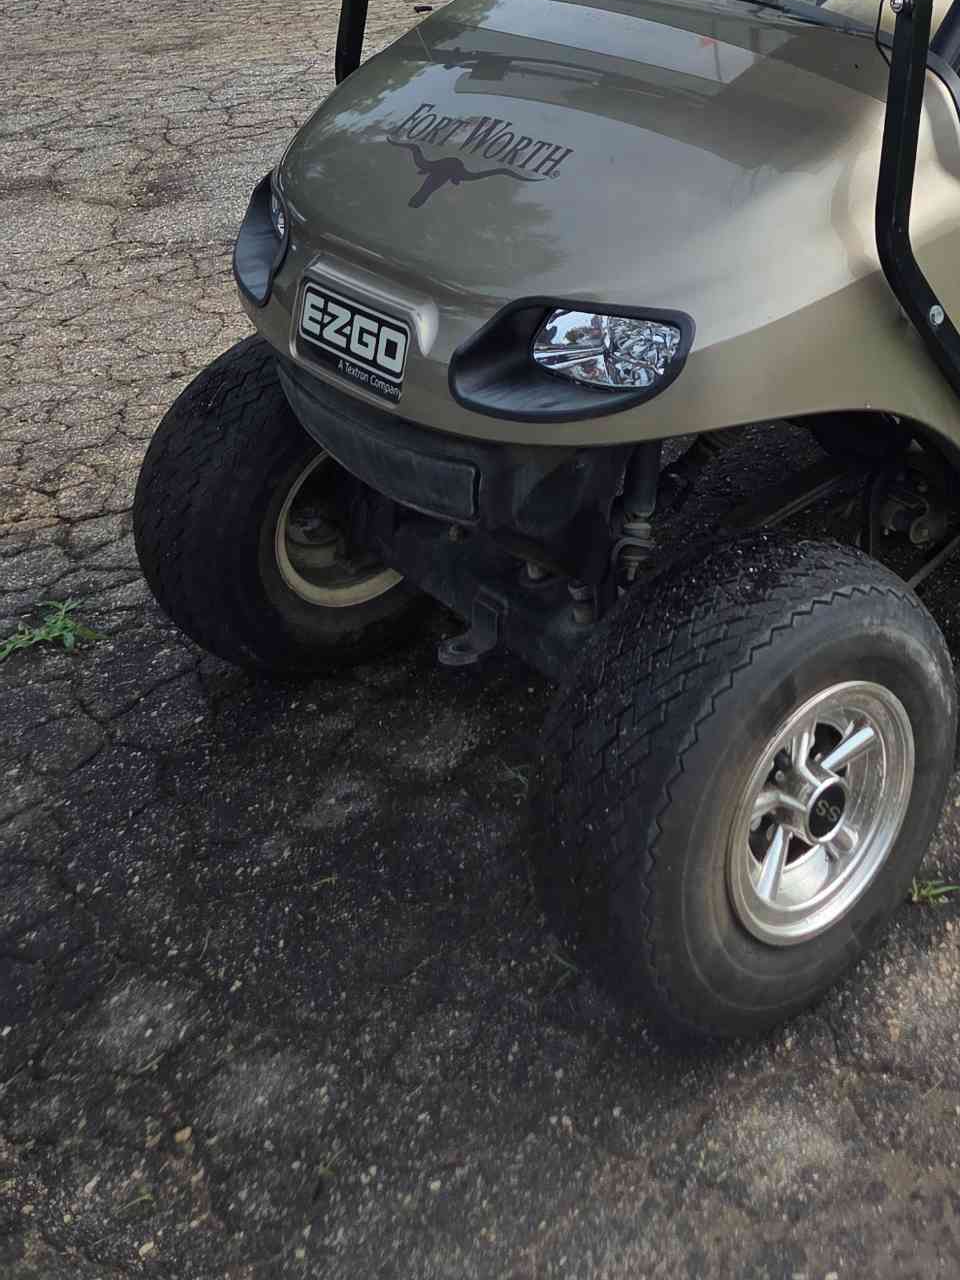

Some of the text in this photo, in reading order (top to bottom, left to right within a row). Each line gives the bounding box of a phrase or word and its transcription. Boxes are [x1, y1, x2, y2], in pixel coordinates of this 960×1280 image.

[395, 103, 575, 177] FORT WORTH
[345, 361, 369, 382] Textron
[369, 375, 401, 401] Company
[815, 799, 841, 822] SS
